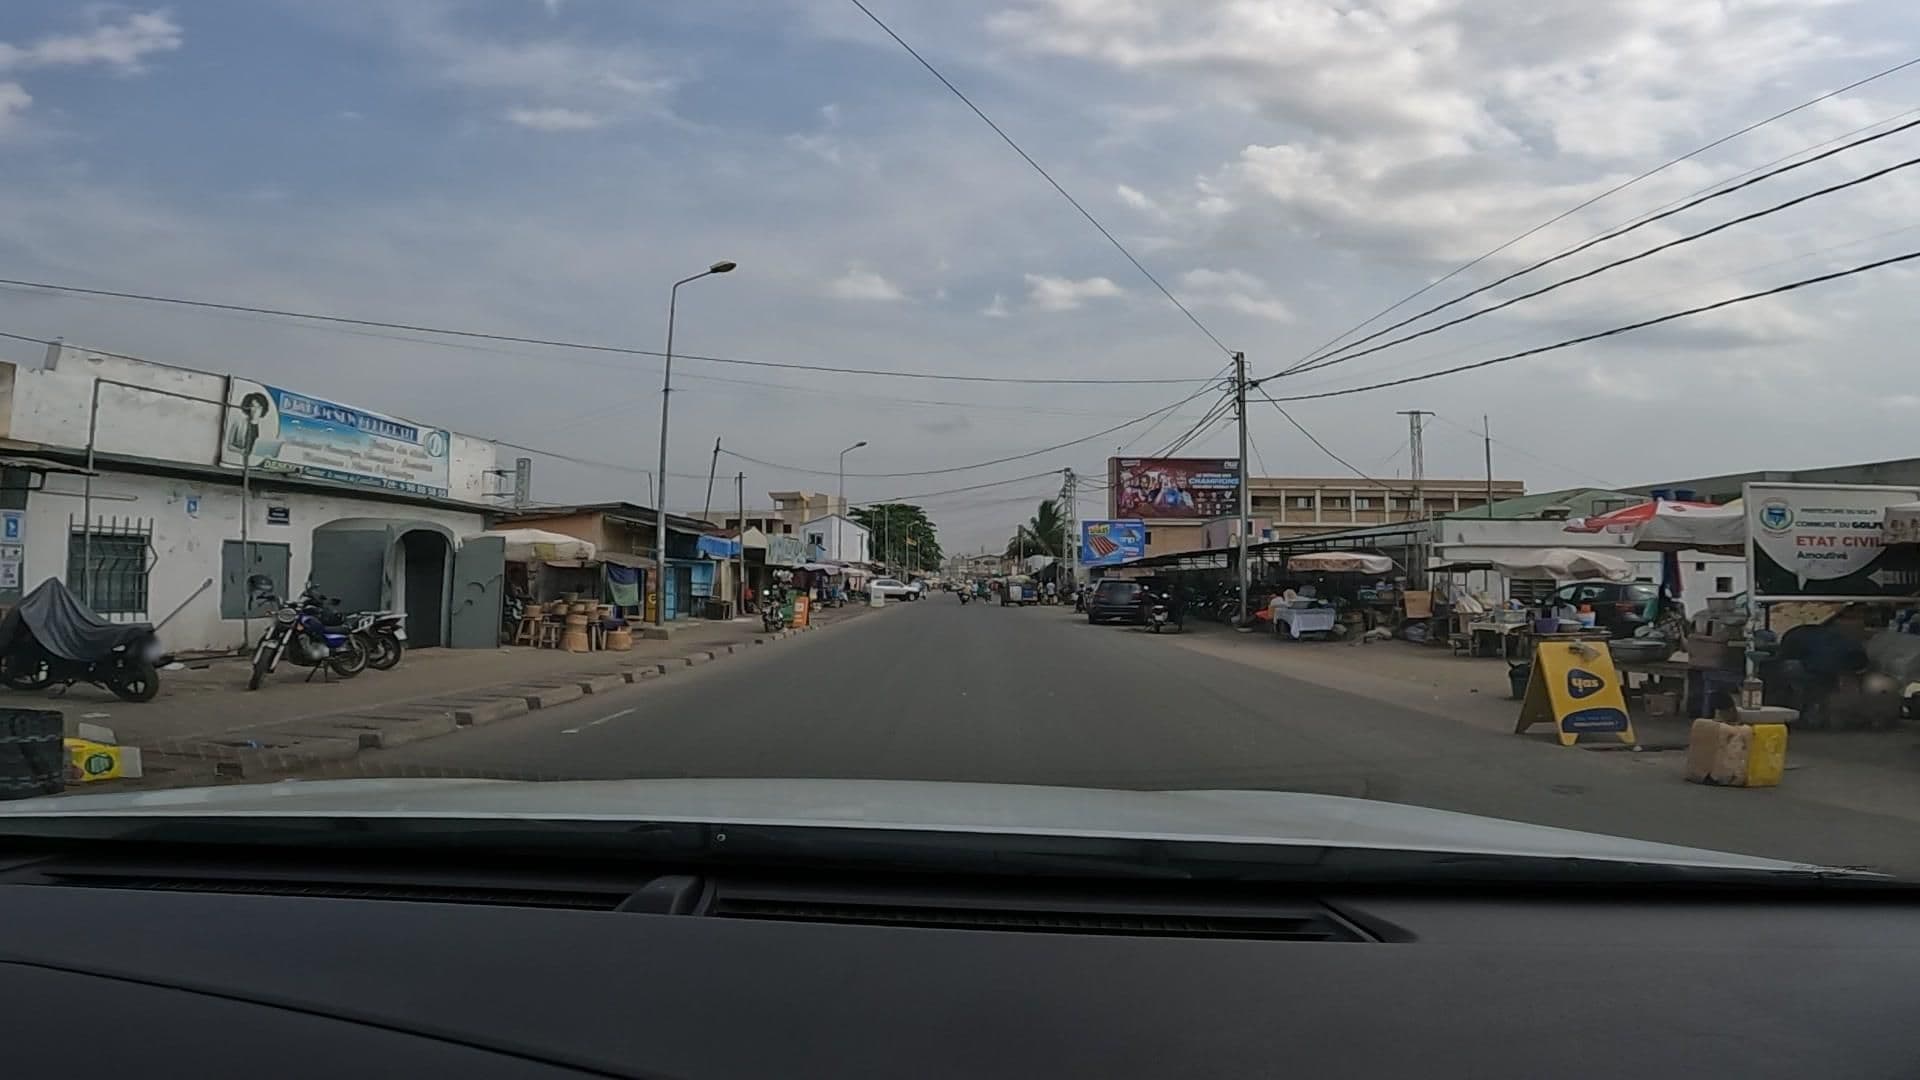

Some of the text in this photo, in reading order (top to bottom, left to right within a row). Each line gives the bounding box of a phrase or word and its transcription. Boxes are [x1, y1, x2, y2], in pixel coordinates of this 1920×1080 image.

[1796, 535, 1883, 548] ETAT CIVIL
[1571, 678, 1598, 692] yas
